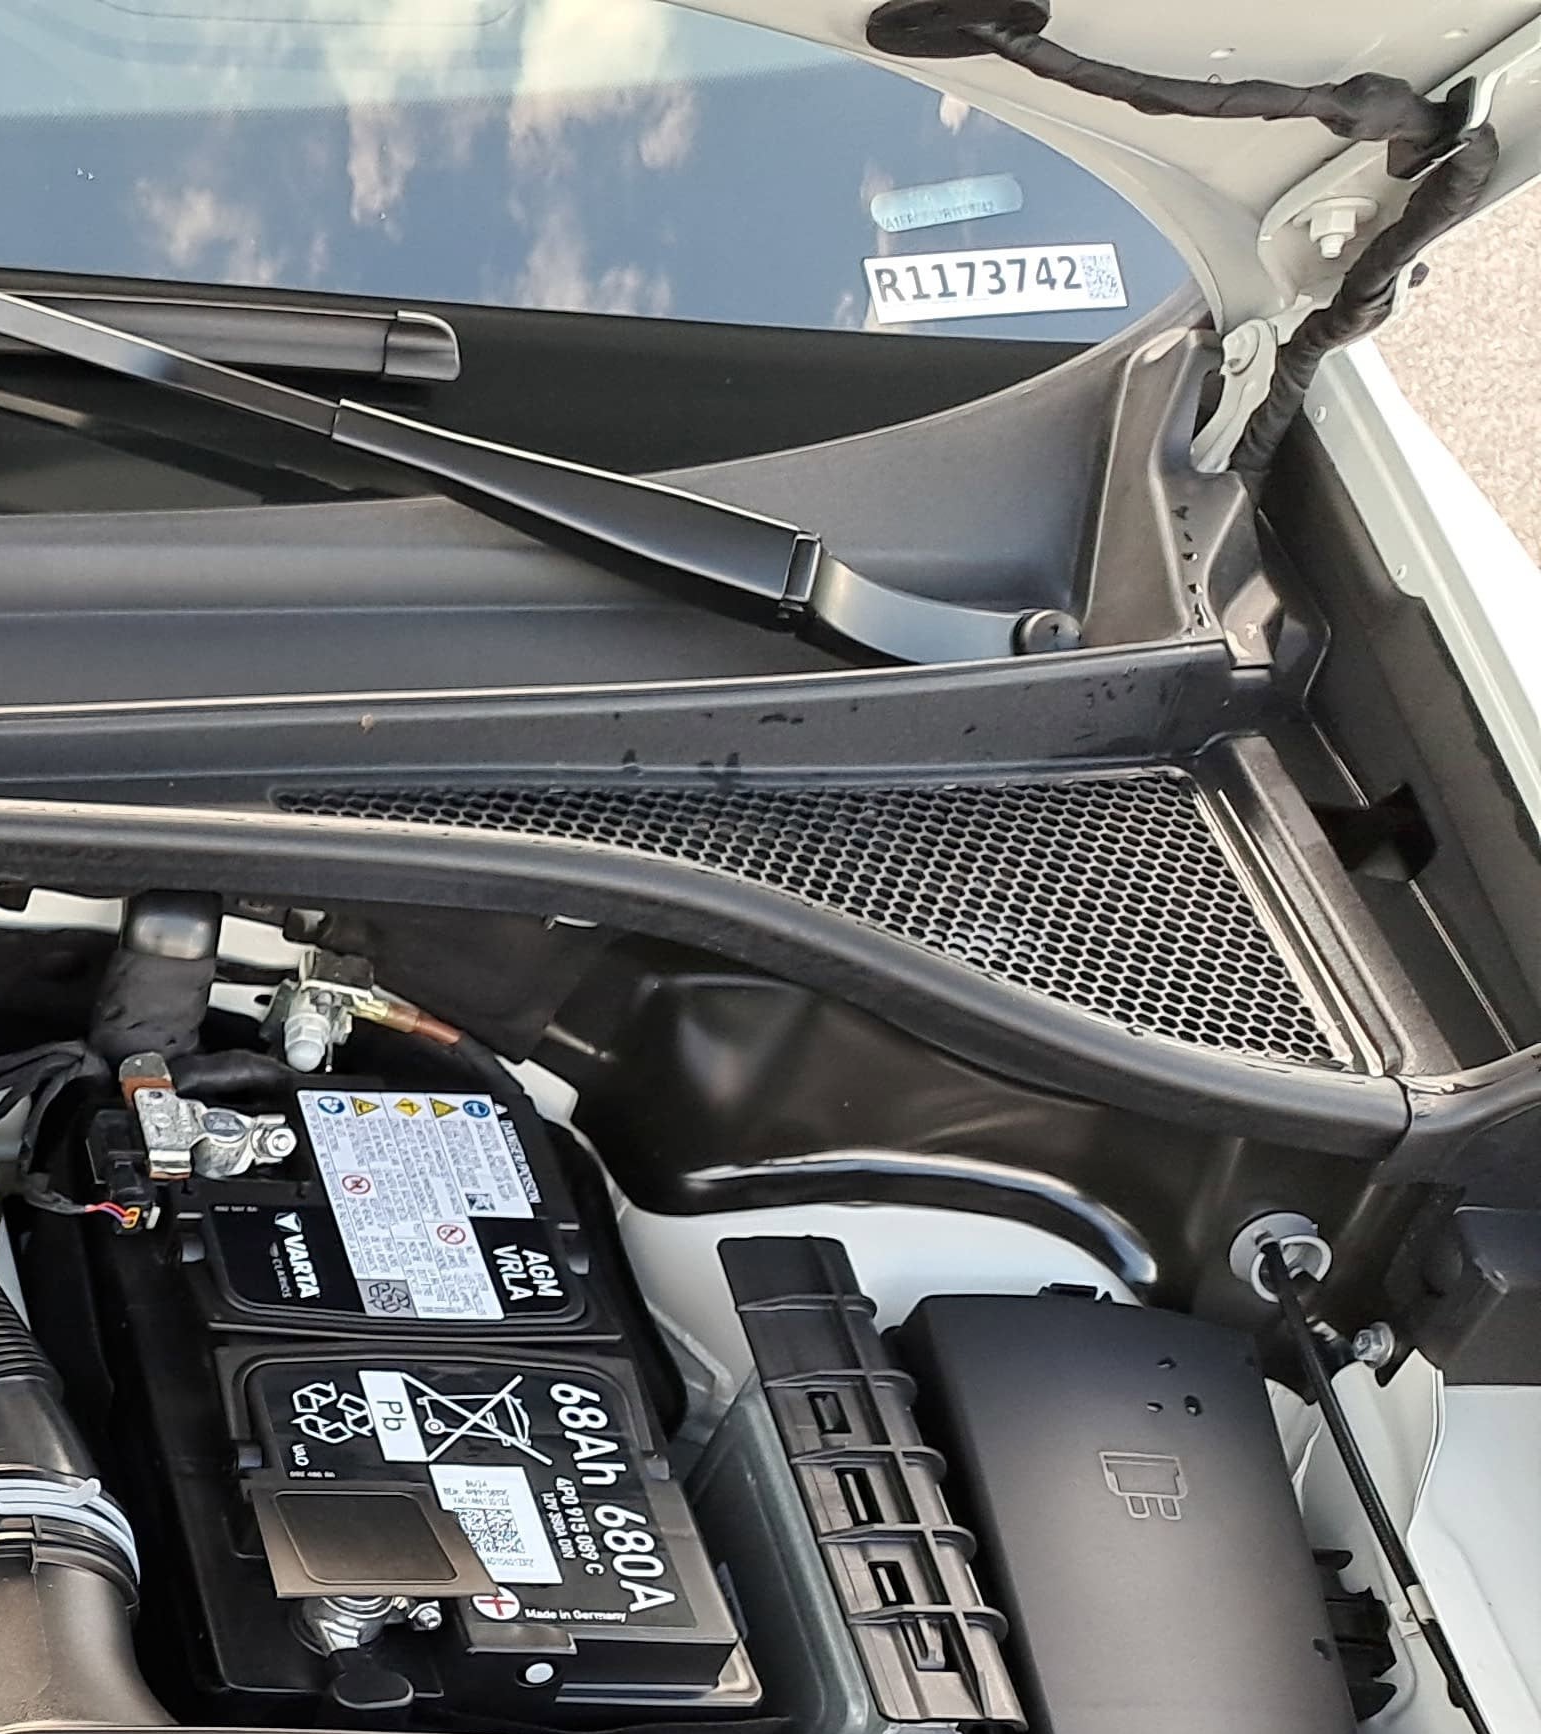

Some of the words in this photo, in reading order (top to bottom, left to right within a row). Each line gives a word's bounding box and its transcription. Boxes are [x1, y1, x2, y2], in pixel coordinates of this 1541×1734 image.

[874, 255, 1082, 303] R1173742
[284, 1233, 320, 1298] VARTA
[493, 1244, 534, 1300] VRLA
[522, 1248, 564, 1297] AGM
[376, 1400, 407, 1431] Pb
[549, 1382, 627, 1486] 68Ah
[594, 1504, 677, 1613] 680A
[568, 1508, 590, 1534] 915
[524, 1608, 556, 1620] Made
[559, 1609, 571, 1620] in
[573, 1610, 627, 1623] Germany
